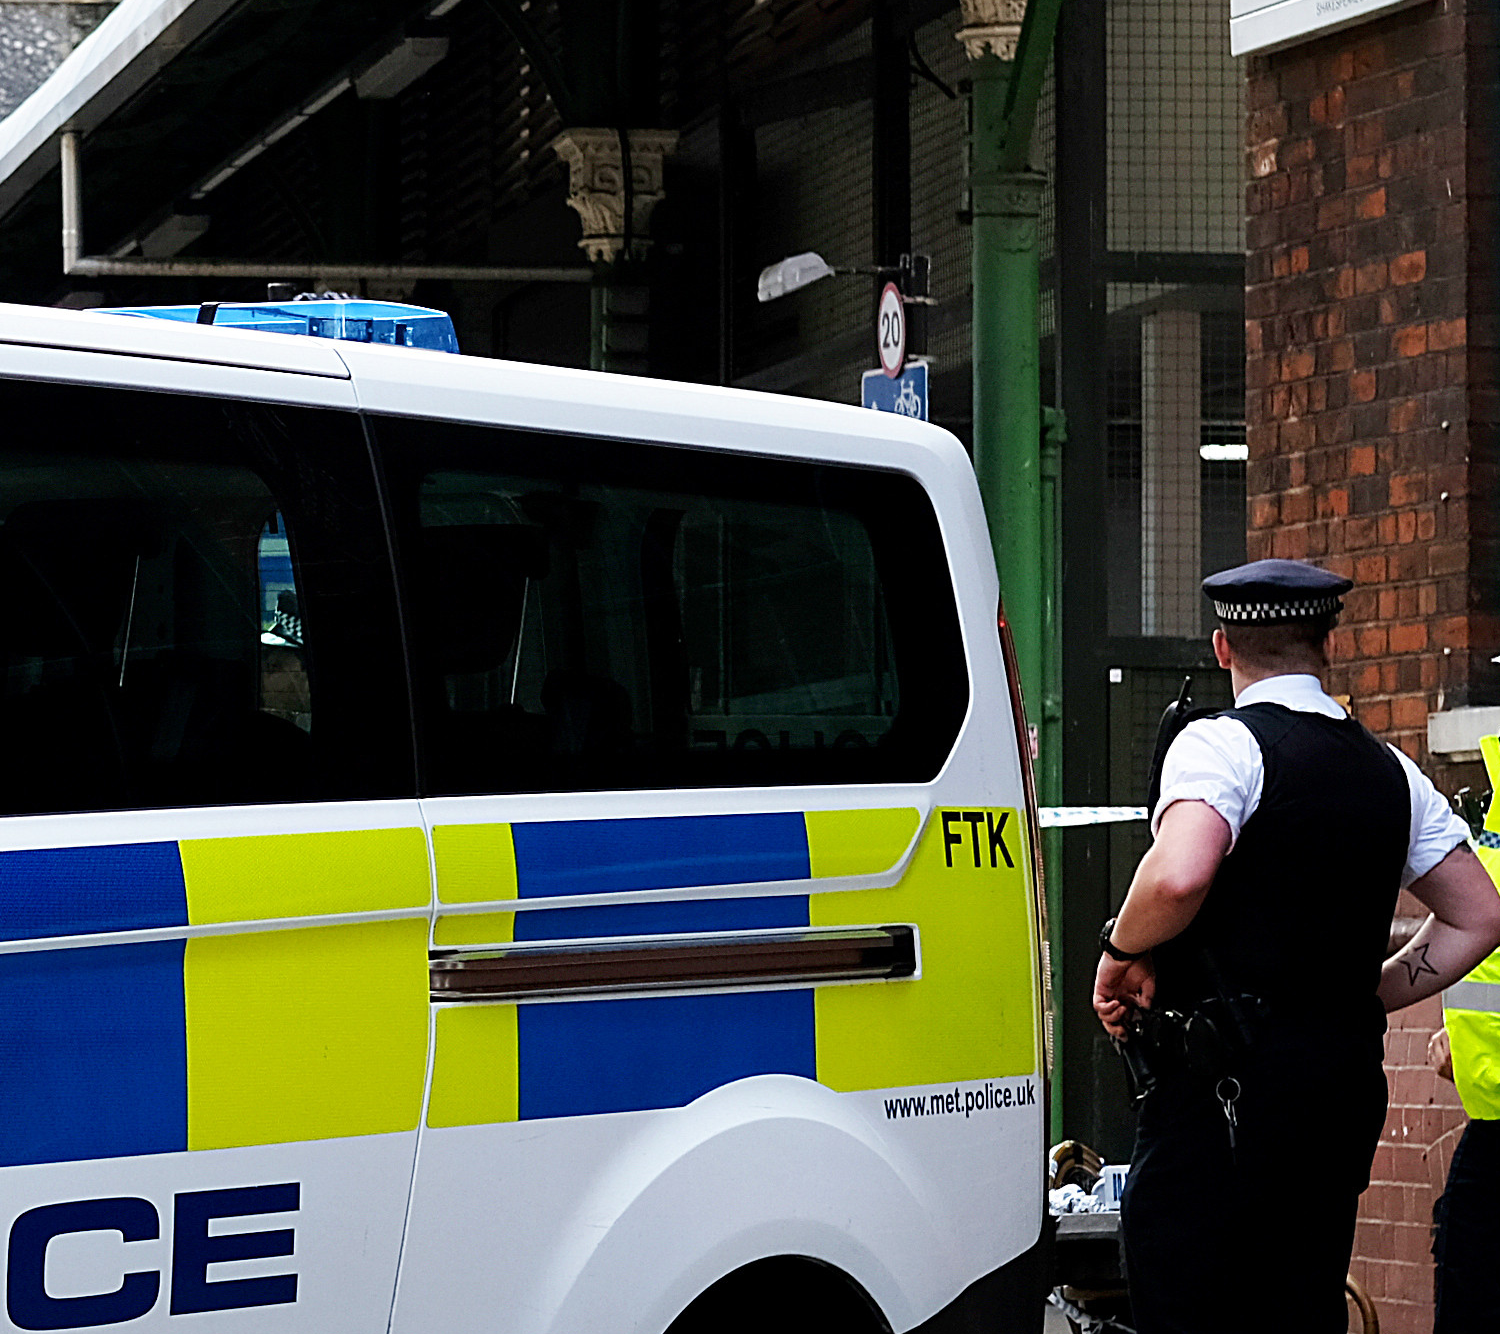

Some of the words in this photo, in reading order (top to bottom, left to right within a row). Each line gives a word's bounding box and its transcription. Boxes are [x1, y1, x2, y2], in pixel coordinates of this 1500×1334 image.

[882, 311, 900, 349] 20
[941, 809, 1016, 870] FTK
[883, 1079, 1036, 1123] www.met.police.uk
